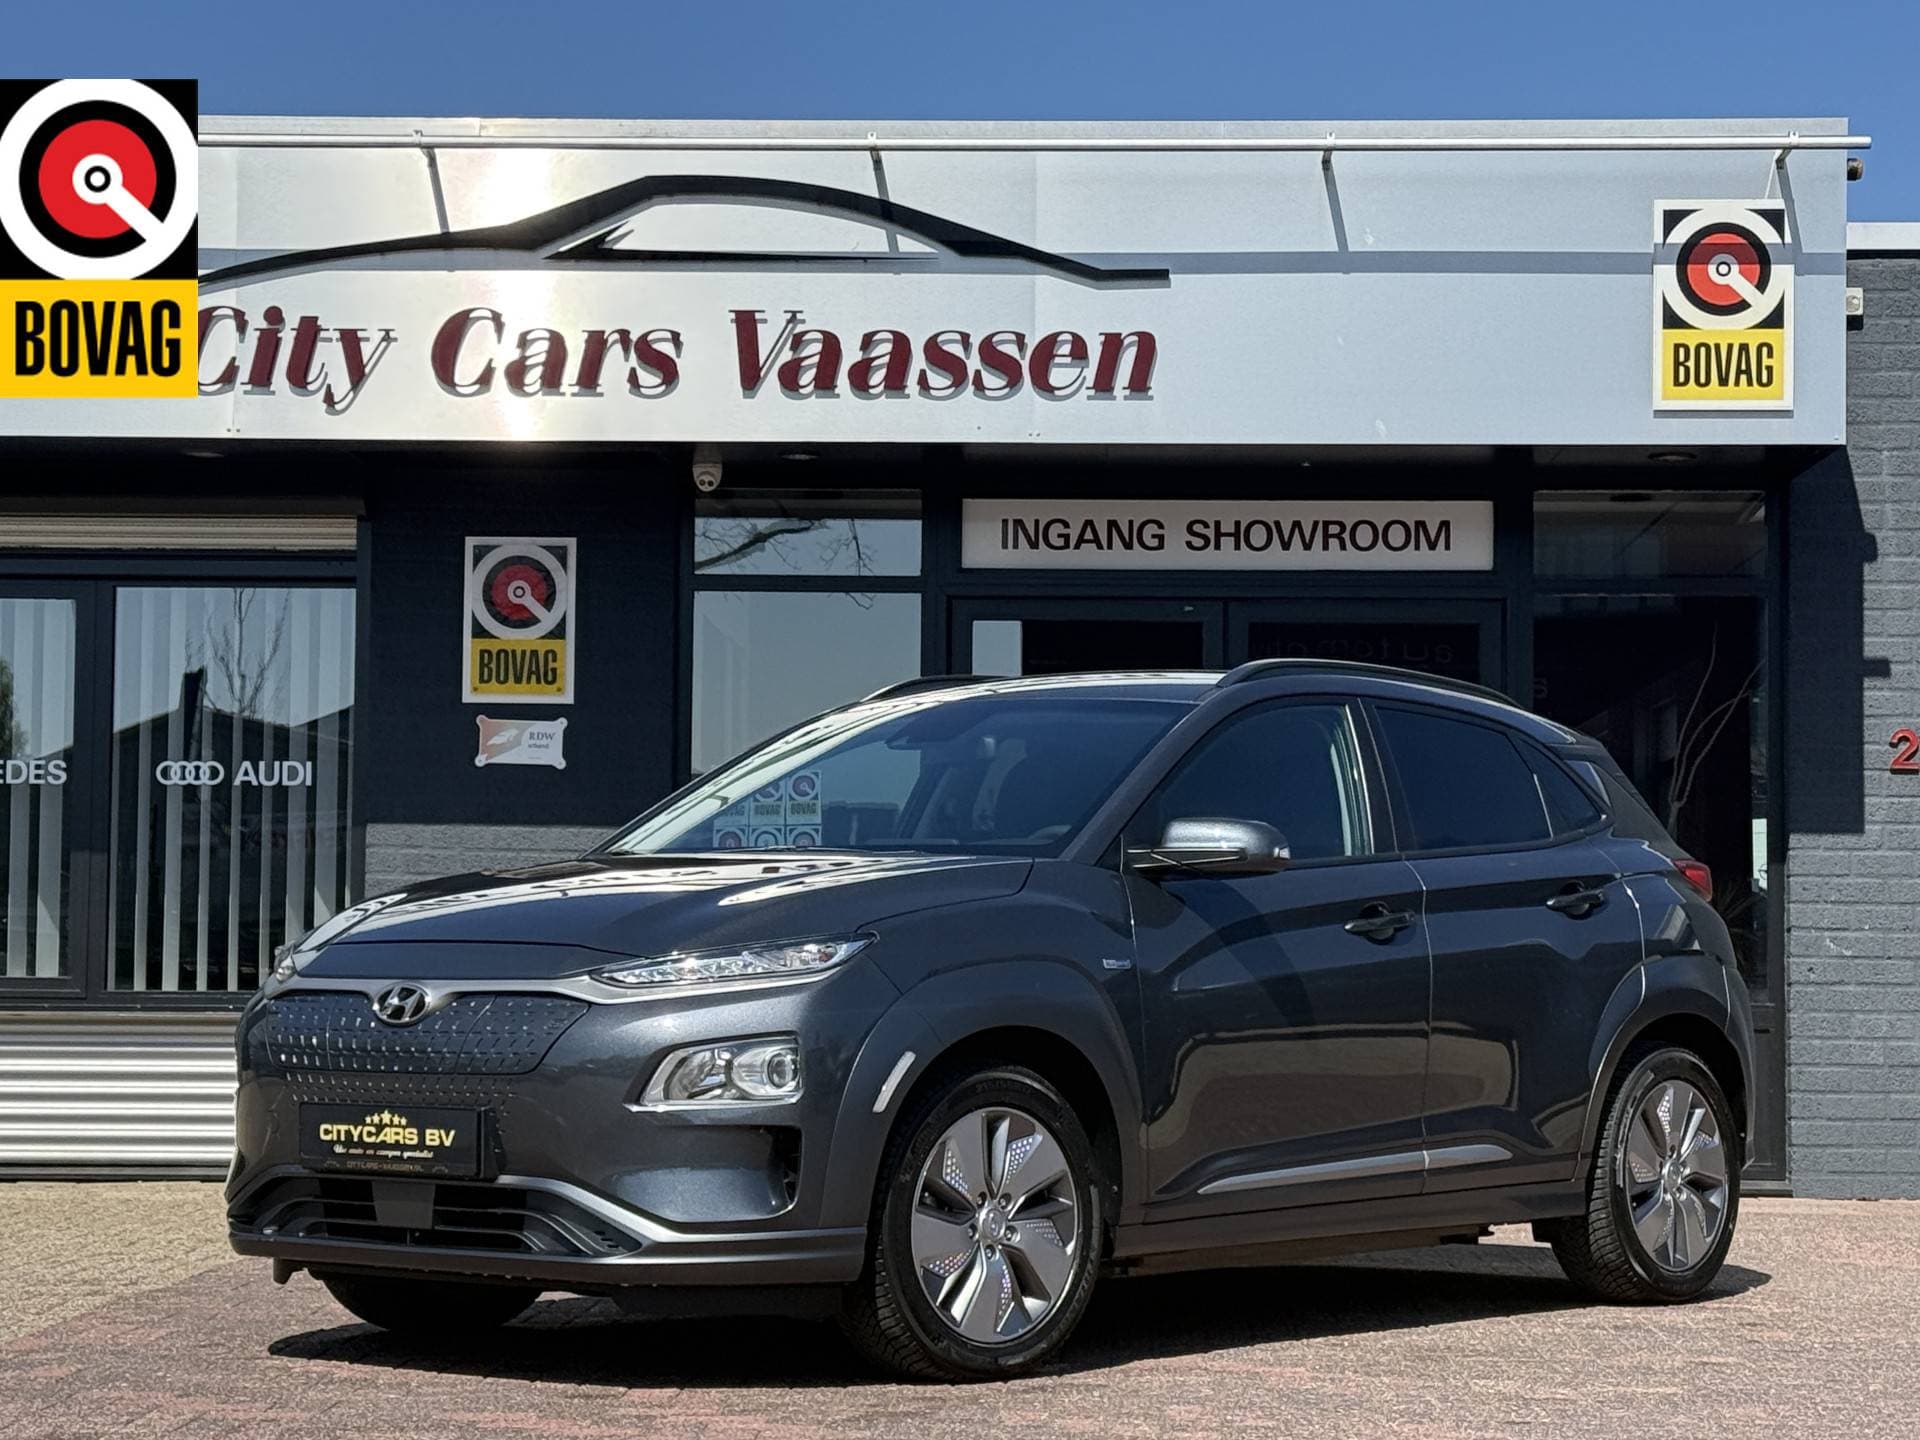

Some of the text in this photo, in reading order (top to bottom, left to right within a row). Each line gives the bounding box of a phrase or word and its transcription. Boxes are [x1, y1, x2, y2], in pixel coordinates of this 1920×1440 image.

[198, 306, 1158, 415] City Cars Vaassen
[1672, 342, 1775, 388] BOVAG
[1001, 517, 1452, 553] INGANG SHOWROOM
[478, 648, 558, 686] BOVAG
[529, 731, 556, 741] RDW
[234, 760, 313, 786] AUDI
[319, 1124, 456, 1147] CITYCARS BV
